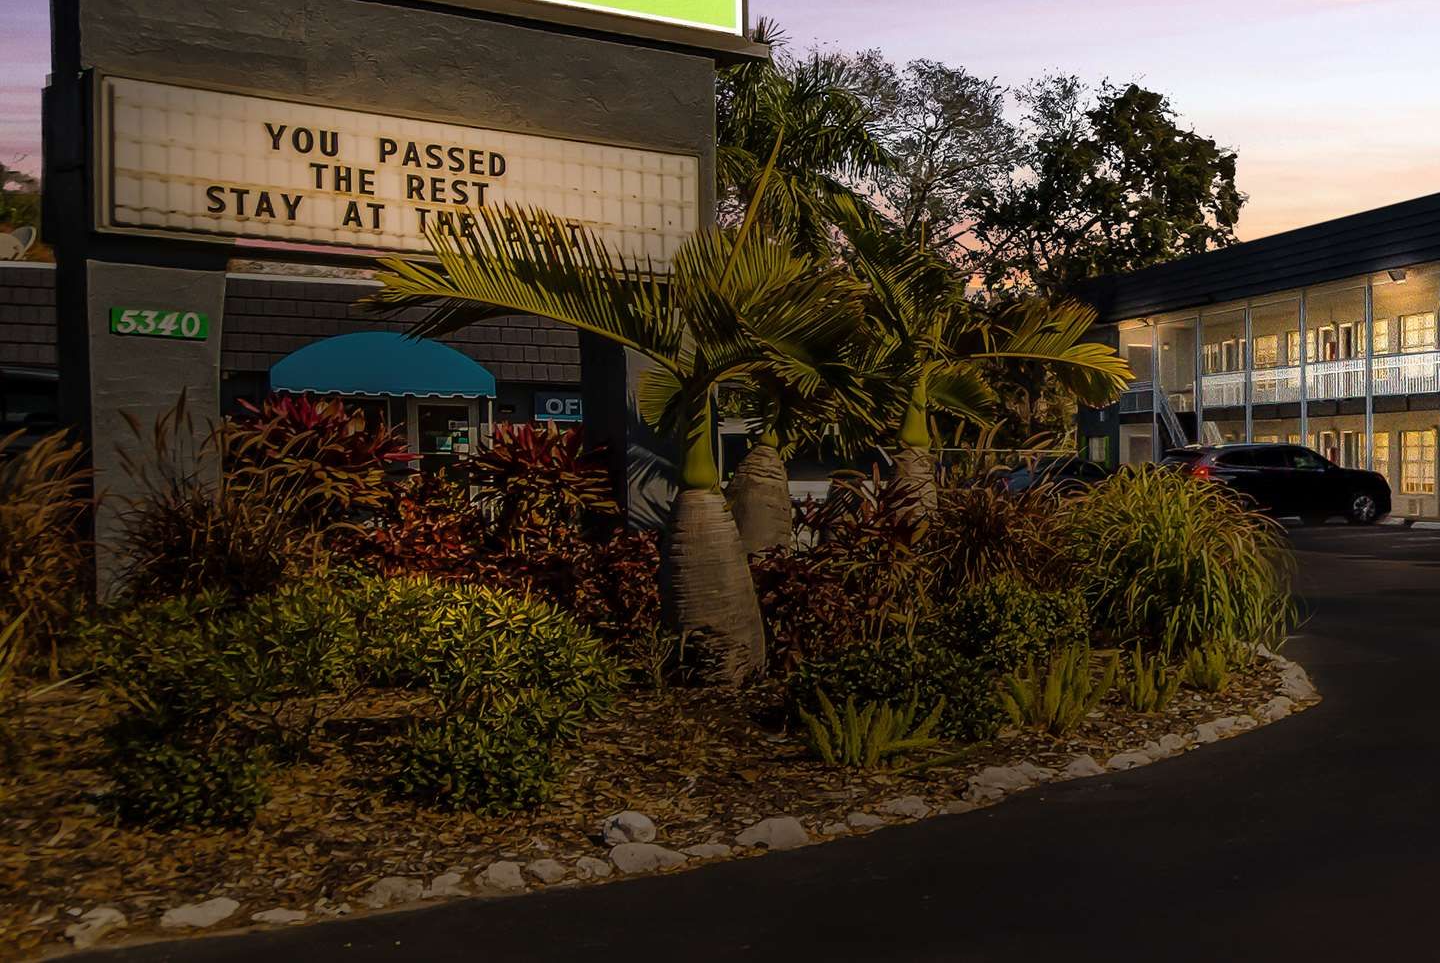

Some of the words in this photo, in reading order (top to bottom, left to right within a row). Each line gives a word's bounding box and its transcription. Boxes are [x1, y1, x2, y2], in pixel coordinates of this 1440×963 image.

[264, 122, 340, 157] YOU
[379, 137, 507, 177] PASSED
[310, 162, 376, 195] THE
[406, 173, 489, 206] REST
[205, 186, 304, 221] STAY
[342, 201, 385, 229] AT
[117, 309, 200, 337] 5340
